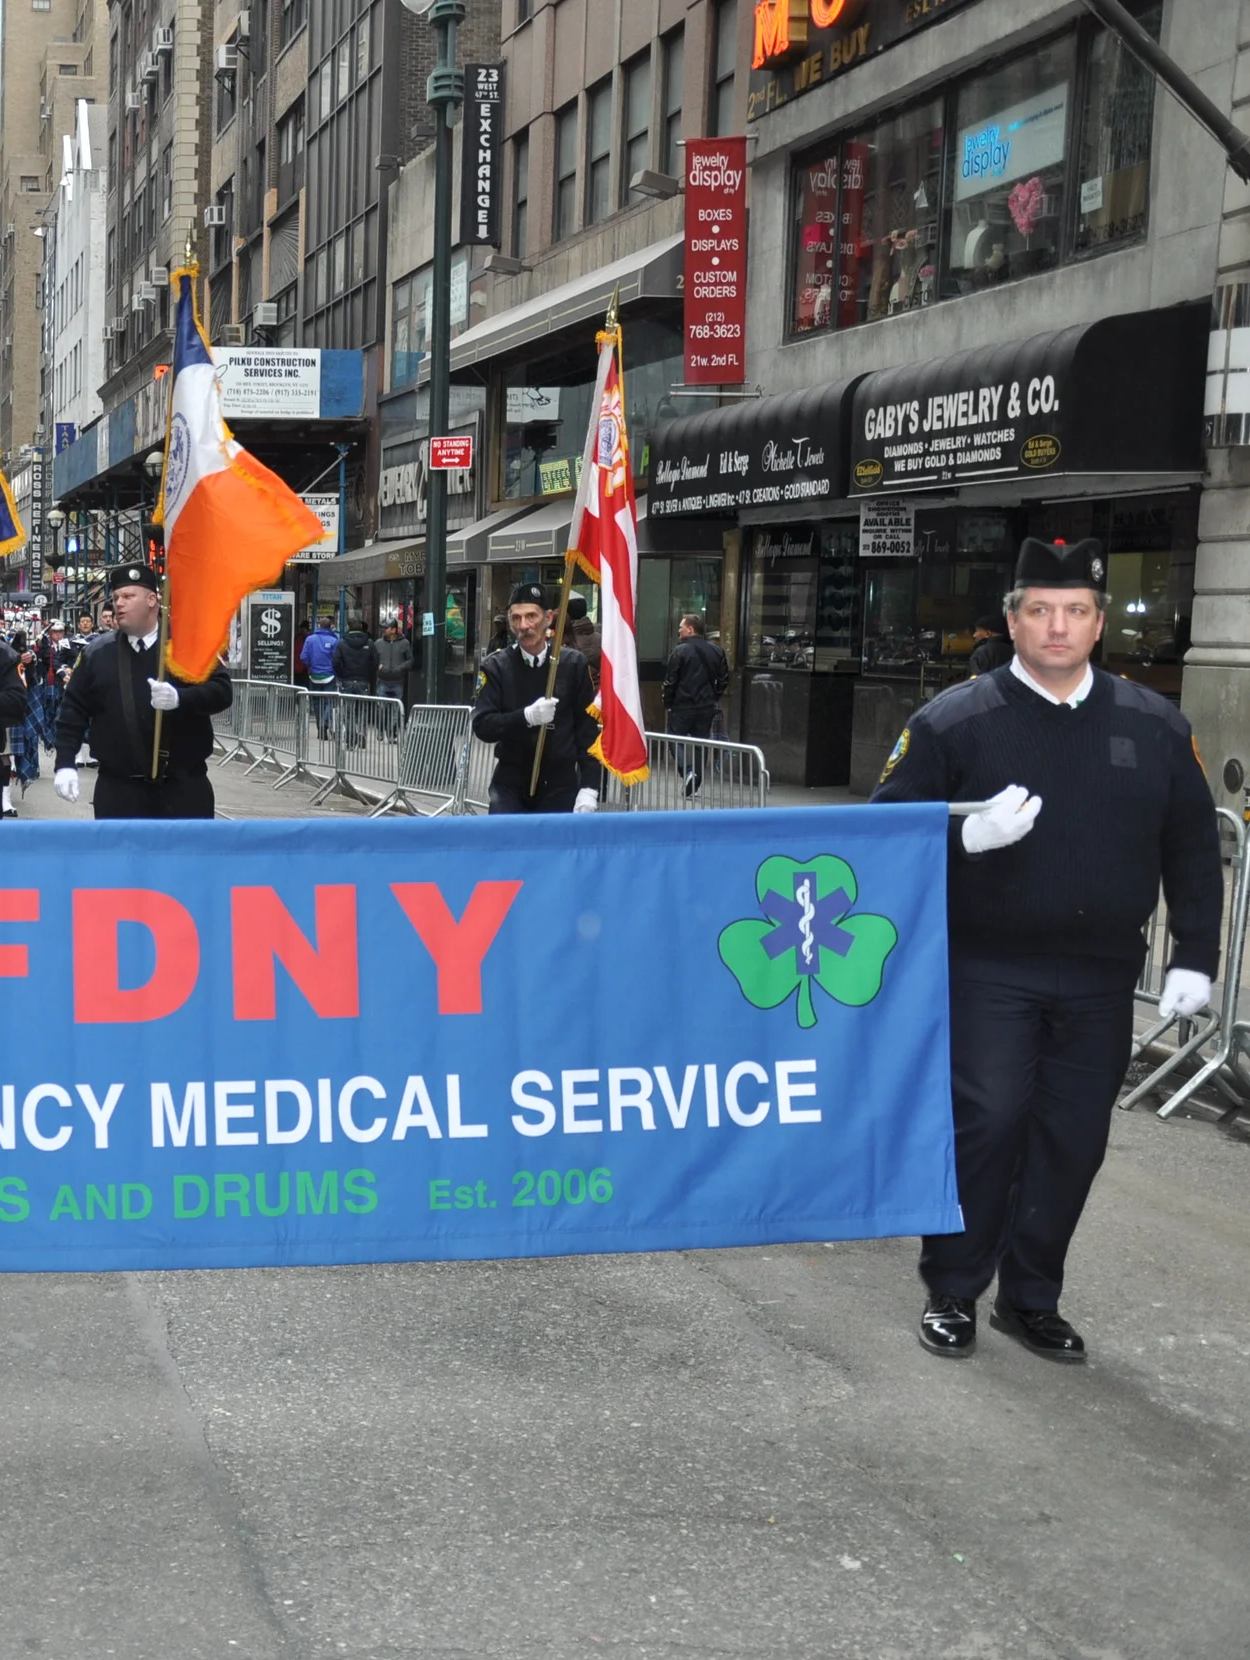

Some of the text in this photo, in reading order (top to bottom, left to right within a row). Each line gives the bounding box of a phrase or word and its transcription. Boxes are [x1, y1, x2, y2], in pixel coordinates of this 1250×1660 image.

[794, 51, 823, 92] WE
[829, 23, 871, 72] BUY
[477, 69, 499, 82] 23
[477, 104, 492, 223] EXCHANGE
[692, 152, 729, 170] jewelry
[961, 141, 1010, 178] display
[689, 165, 743, 191] display
[698, 208, 733, 221] BOXES
[691, 239, 739, 252] DISPLAYS
[694, 271, 737, 284] CUSTOM
[694, 285, 737, 298] ORDERS
[705, 312, 725, 323] (212)
[689, 324, 741, 338] 768-3623
[229, 357, 317, 367] PILKU CONSTRUCTION
[690, 354, 739, 367] 21w. 2nd FL
[244, 368, 301, 378] SERVICES INC.
[864, 375, 1060, 440] GABY'S JEWELRY & CO.
[443, 440, 469, 448] STANDING
[884, 428, 1016, 458] DIAMONDS JEWELRY WATCHES
[894, 447, 1002, 472] WE BUY GOLD & DIAMONDS
[752, 486, 780, 503] CREATIONS
[784, 483, 800, 500] GOLD
[800, 479, 830, 498] STANDARD
[304, 497, 337, 505] METALS
[32, 464, 42, 567] ROSS REFINERS
[863, 518, 912, 527] AVAILABLE
[871, 541, 911, 554] 869-0052
[151, 1073, 488, 1148] MEDICAL
[511, 1059, 822, 1138] SERVICE
[49, 1182, 153, 1221] AND
[173, 1168, 378, 1219] DRUMS
[430, 1179, 498, 1211] Est.
[511, 1167, 614, 1207] 2006
